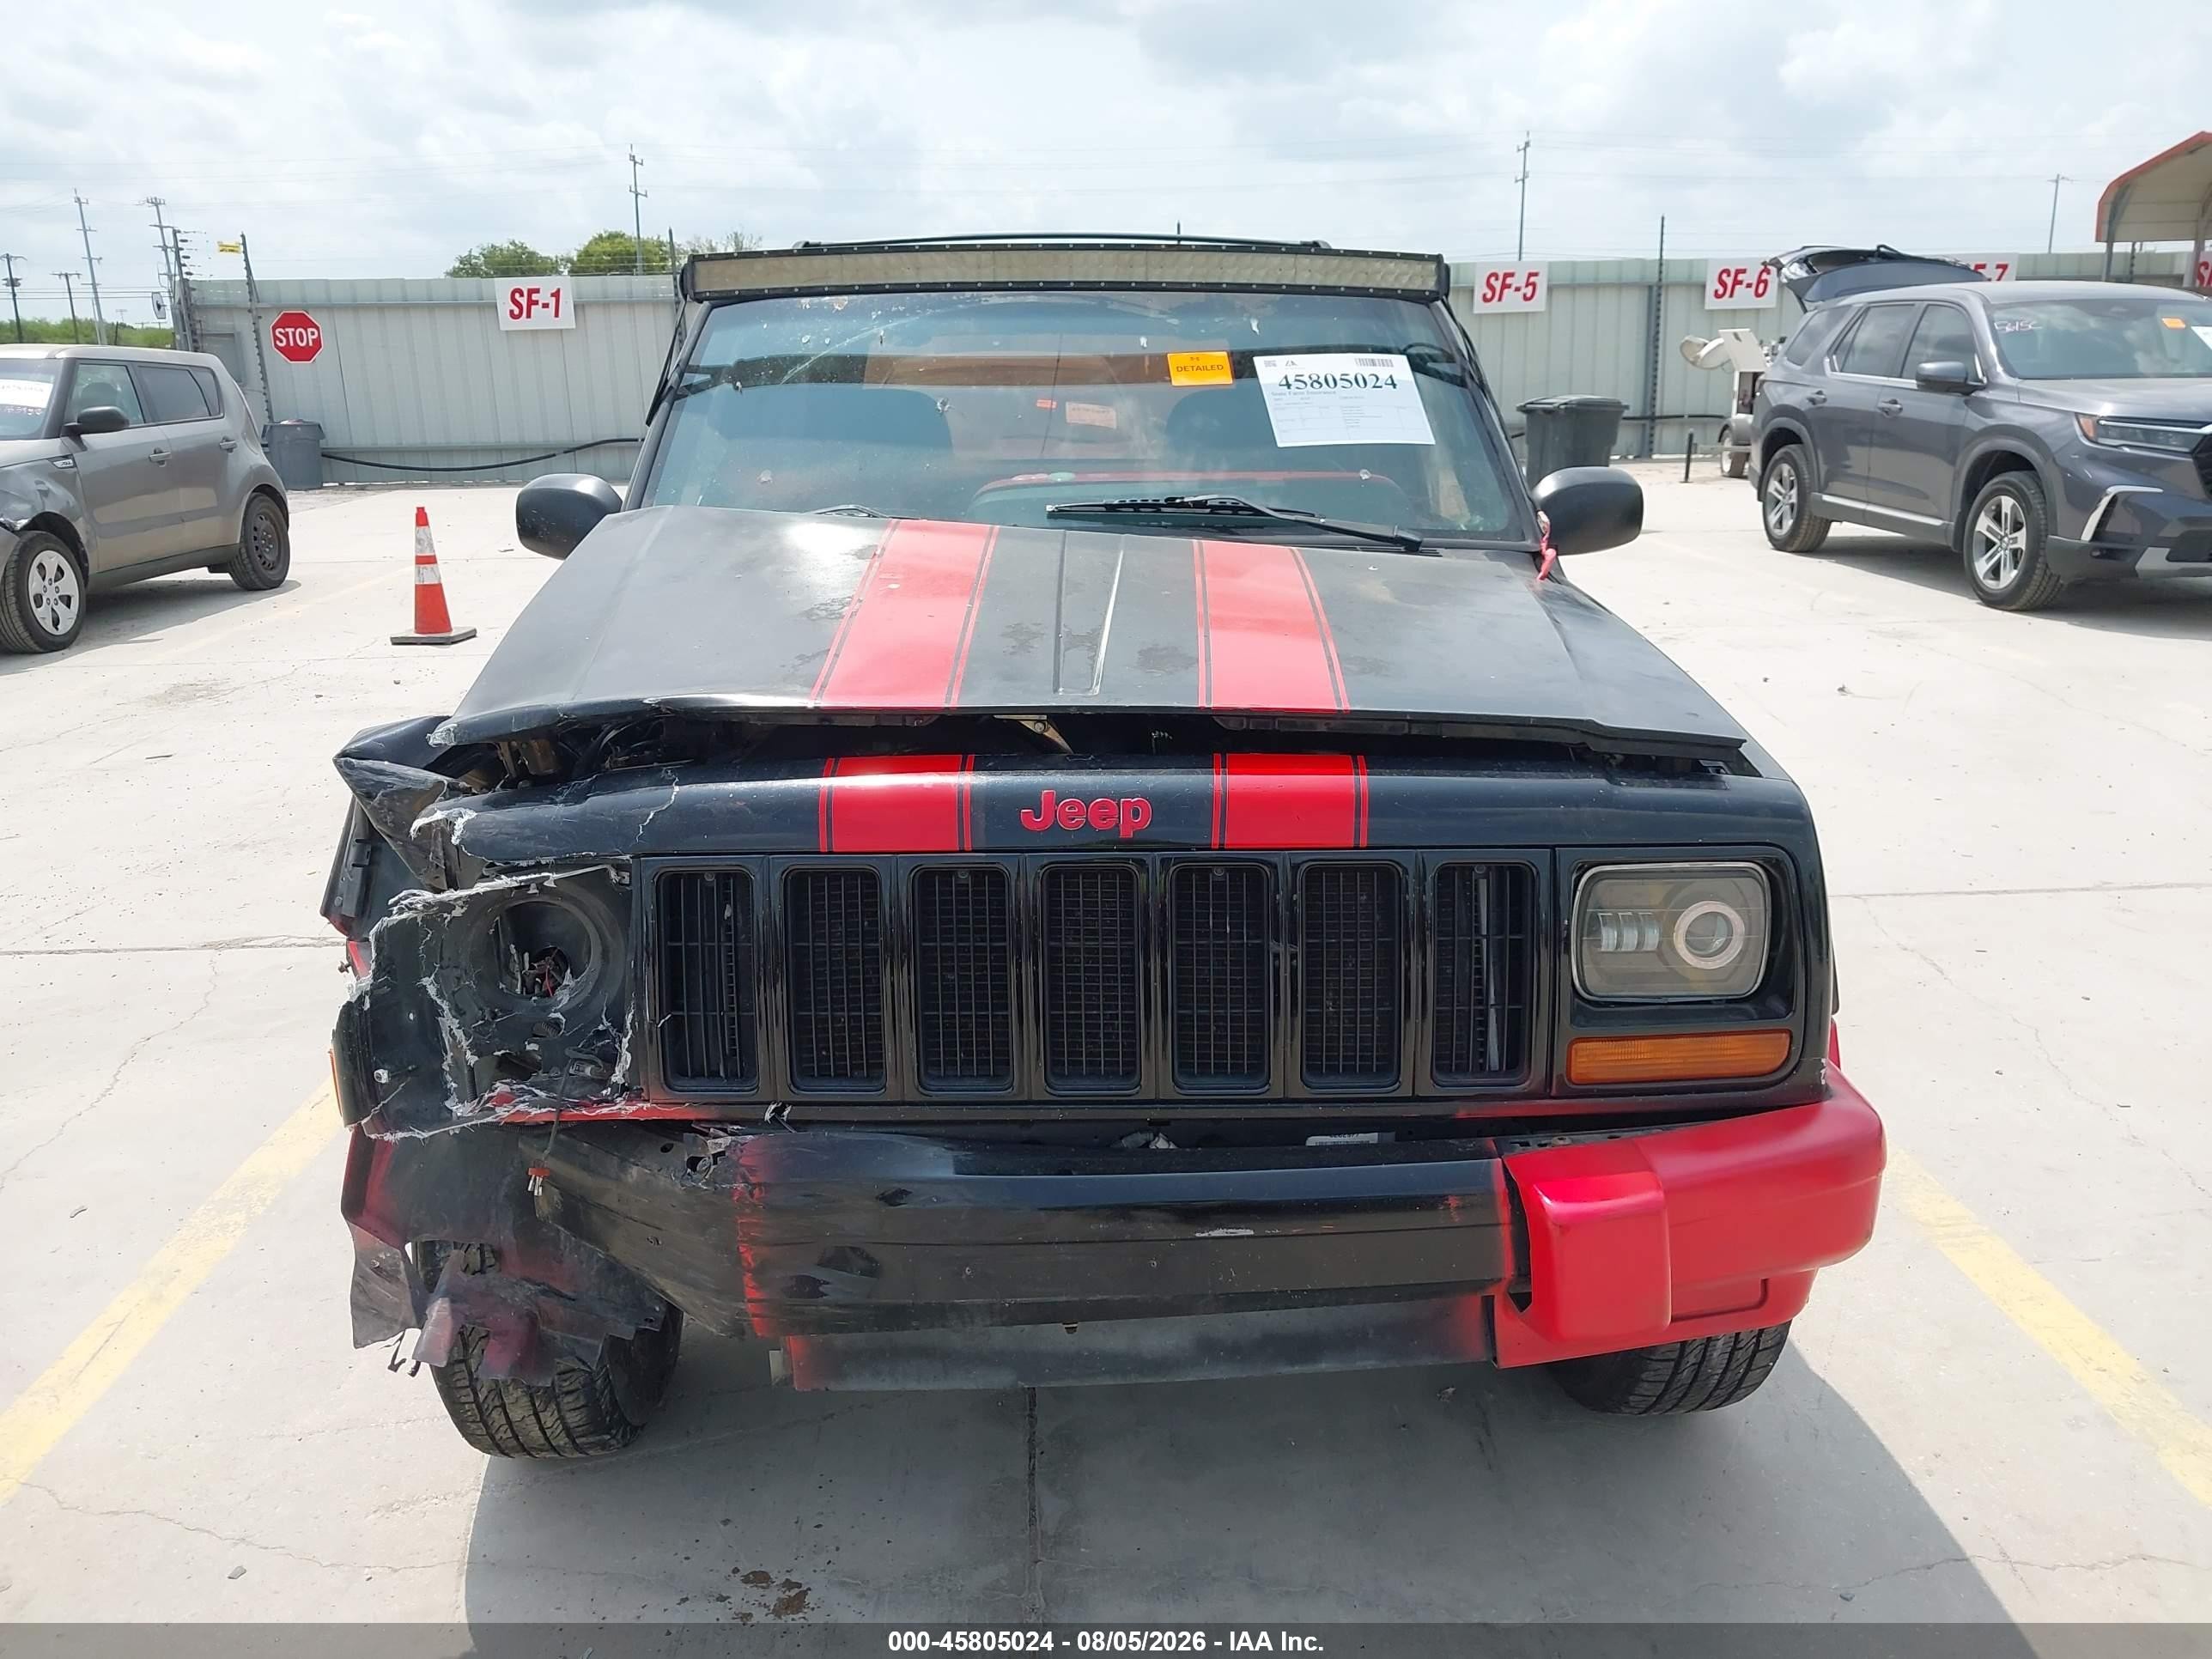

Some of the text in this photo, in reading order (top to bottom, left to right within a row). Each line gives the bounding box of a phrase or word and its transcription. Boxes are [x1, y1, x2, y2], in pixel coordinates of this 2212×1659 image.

[1482, 271, 1539, 303] SF-5
[1714, 265, 1771, 299] SF-6
[508, 288, 562, 320] SF-1
[275, 327, 319, 347] STOP
[1176, 364, 1224, 373] DETAILED
[1278, 372, 1398, 390] 45805024
[1020, 789, 1152, 838] Jeep
